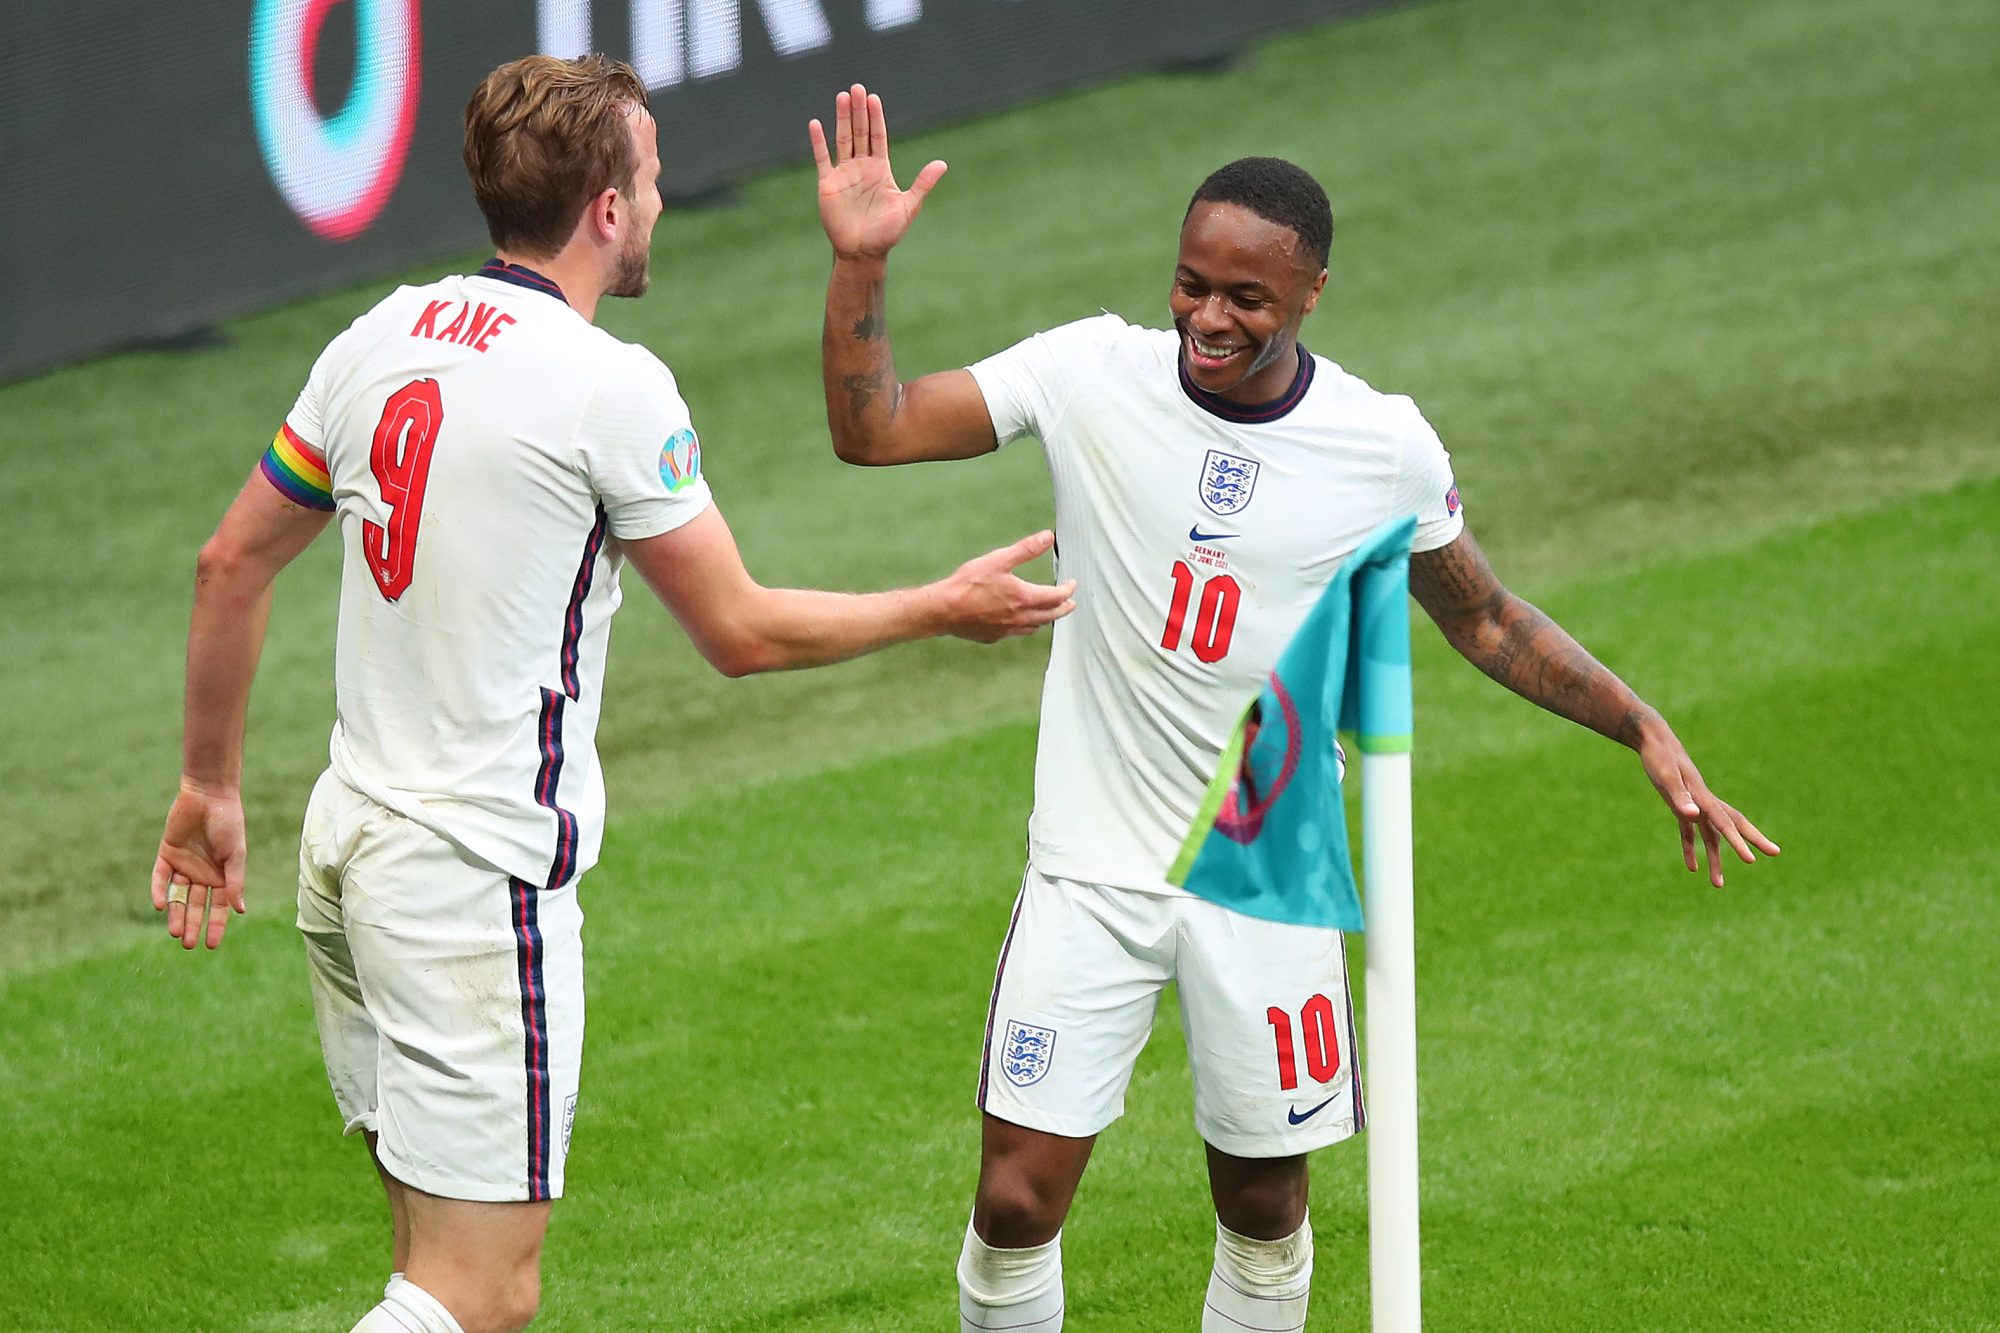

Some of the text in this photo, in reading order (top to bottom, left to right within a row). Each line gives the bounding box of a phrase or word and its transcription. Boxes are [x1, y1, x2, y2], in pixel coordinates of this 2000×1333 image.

[410, 300, 517, 353] KANE
[363, 378, 444, 602] 9
[1195, 545, 1226, 560] GERMANY
[1197, 555, 1213, 566] JUNE
[1214, 560, 1229, 569] 2021
[1160, 560, 1241, 663] 10
[1266, 993, 1340, 1091] 10
